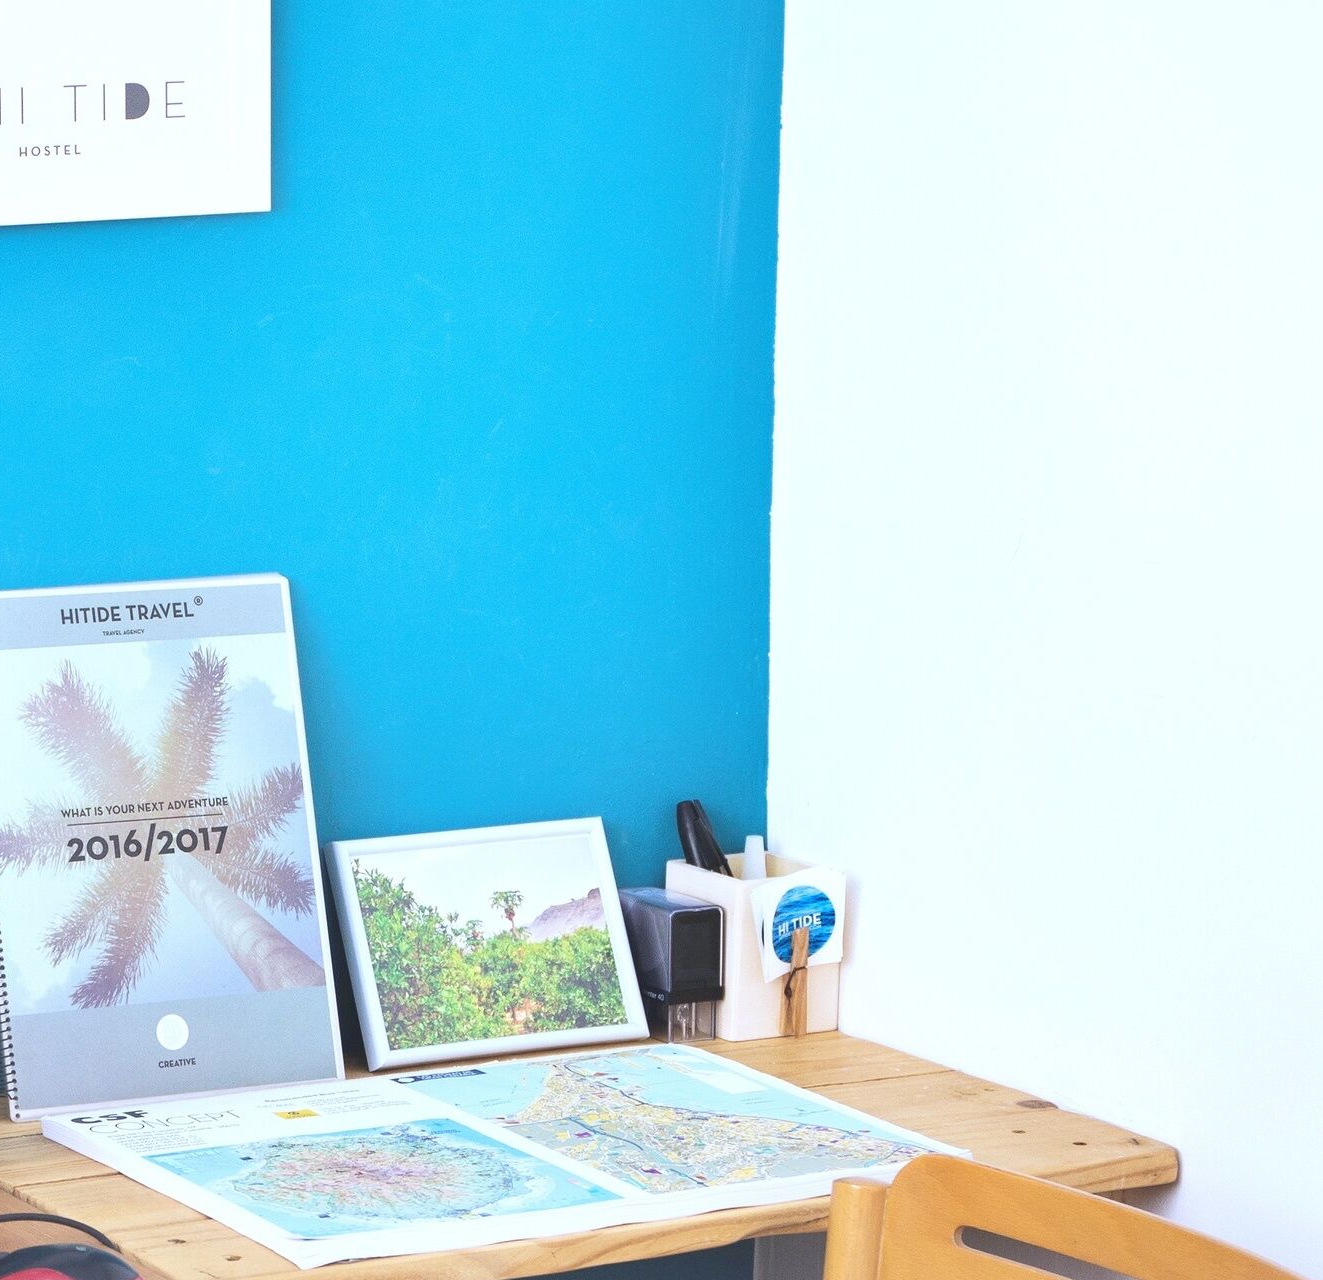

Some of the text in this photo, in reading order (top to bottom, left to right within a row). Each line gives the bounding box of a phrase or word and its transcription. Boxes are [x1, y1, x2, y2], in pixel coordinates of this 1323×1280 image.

[63, 81, 185, 122] TIDE
[19, 144, 81, 157] HOSTEL
[60, 605, 121, 625] HITIDE
[60, 796, 229, 818] WHAT IS YOUR NEXT ADVENTURE
[67, 823, 228, 863] 2016/2017
[778, 912, 822, 936] HI TIDE
[158, 1058, 196, 1068] CREATIVE
[70, 1109, 148, 1125] CSF
[89, 1109, 241, 1134] CONCEPT
